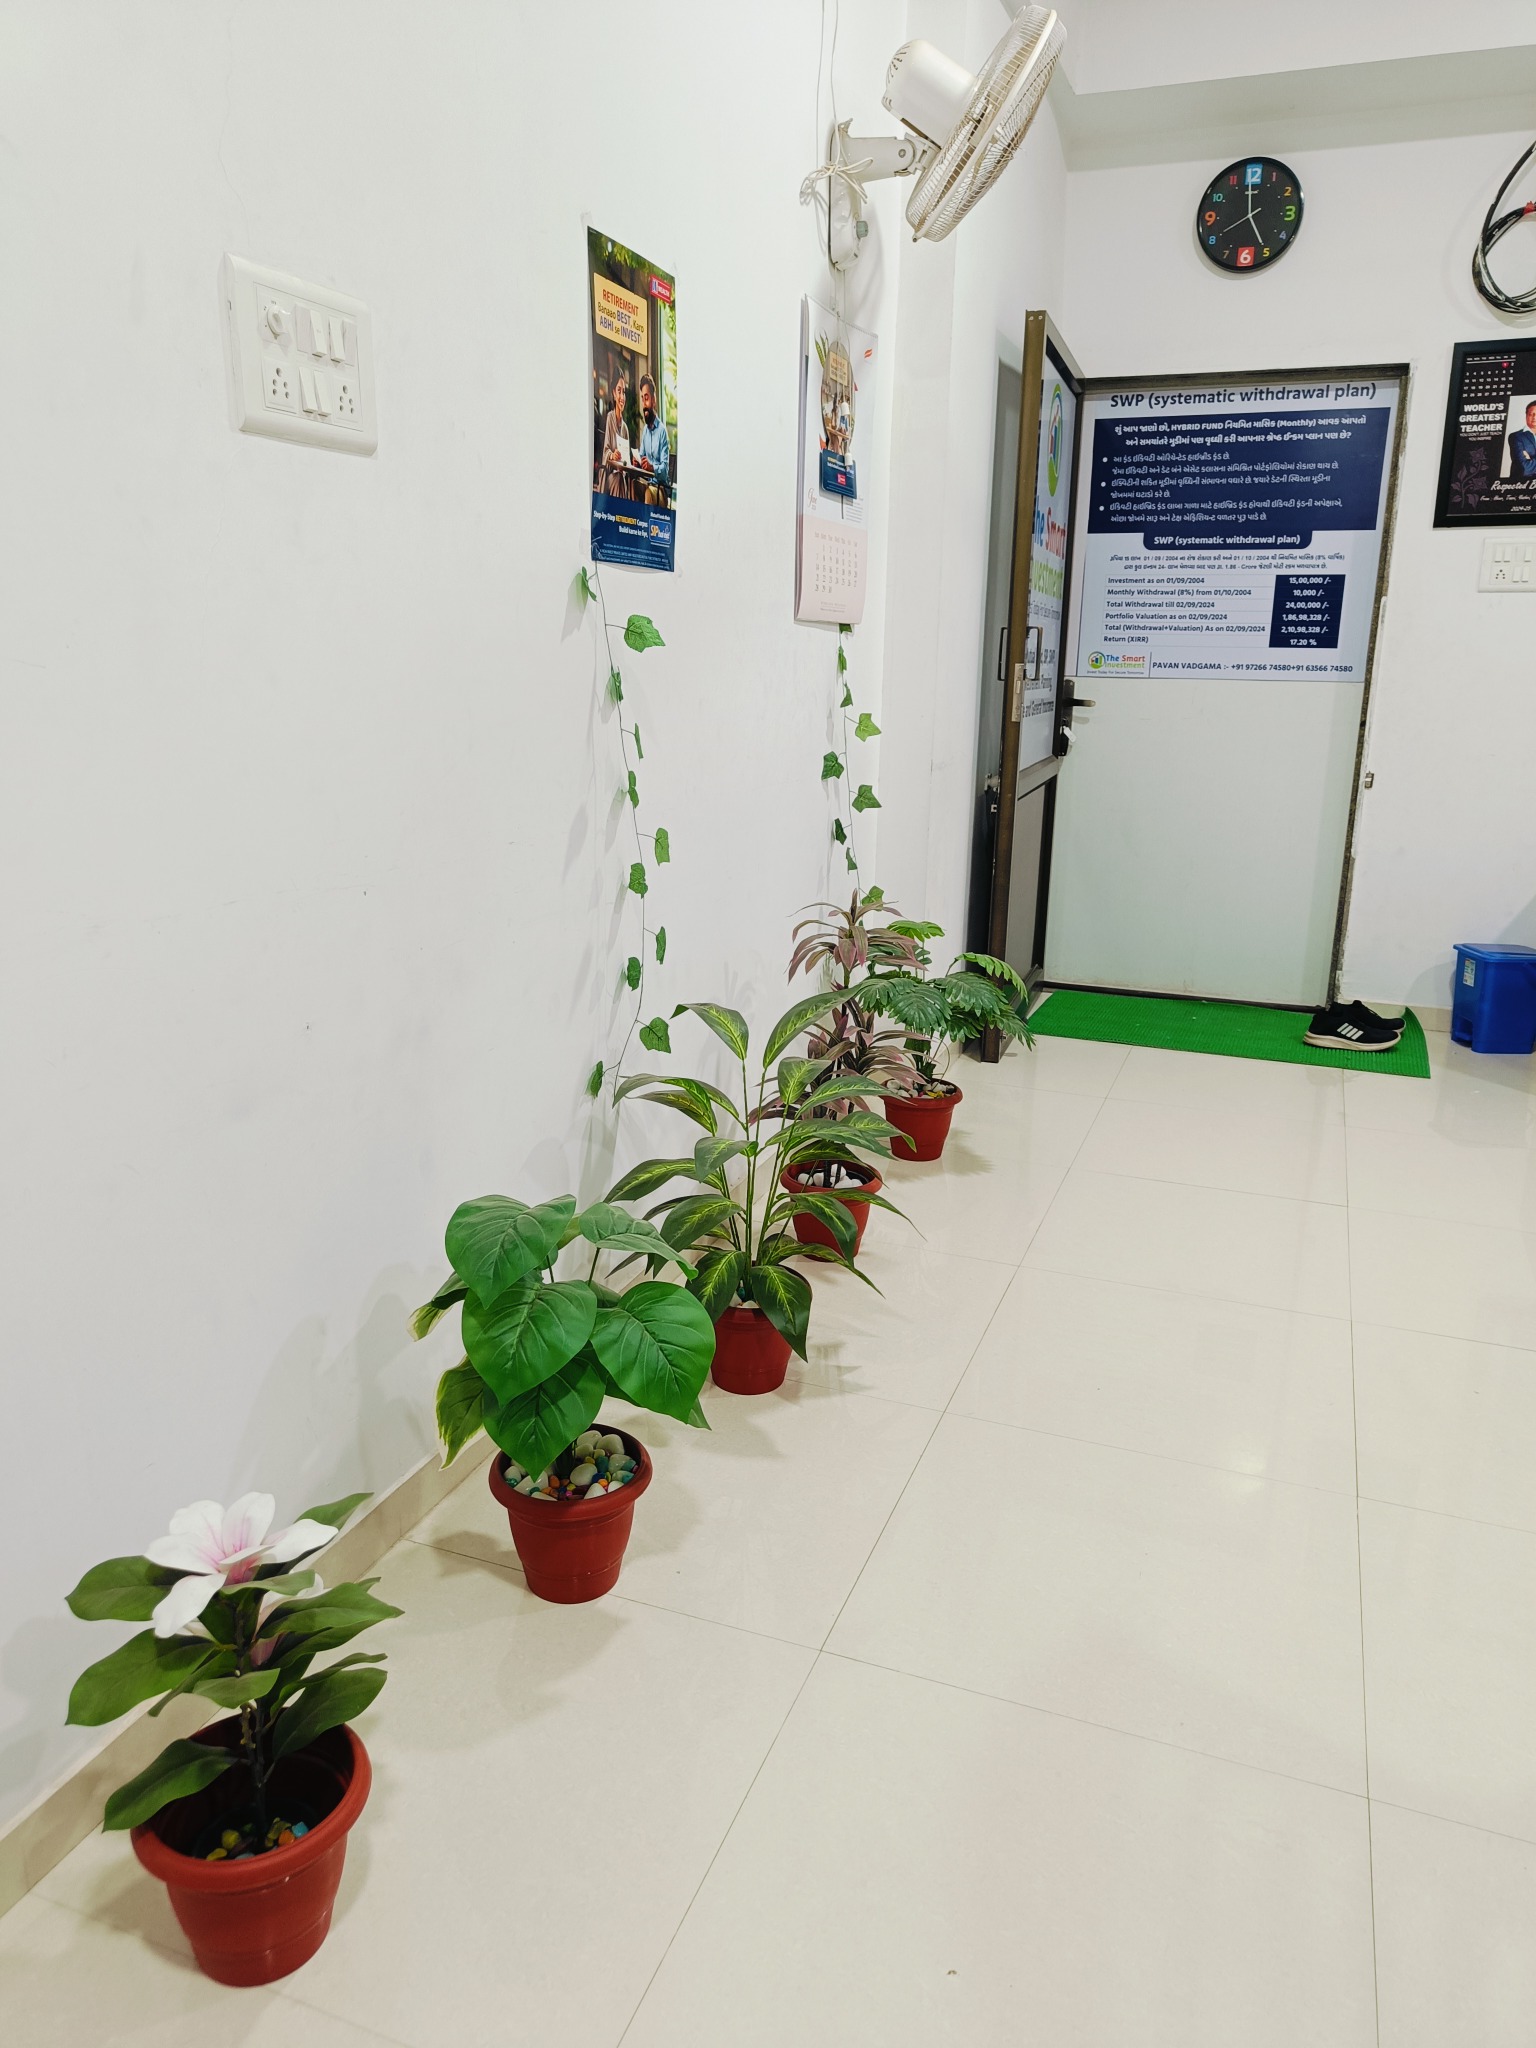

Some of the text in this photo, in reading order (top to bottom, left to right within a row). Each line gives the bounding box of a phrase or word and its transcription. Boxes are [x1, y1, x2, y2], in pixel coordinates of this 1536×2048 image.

[1247, 168, 1261, 182] 12
[1272, 173, 1277, 181] 1
[1230, 176, 1237, 184] 11
[1284, 187, 1291, 196] 2
[1213, 194, 1223, 202] 10
[1284, 206, 1295, 221] 3
[1205, 212, 1216, 225] 9
[1208, 236, 1216, 244] 8
[1279, 231, 1286, 240] 4
[1240, 250, 1251, 263] 6
[1263, 248, 1270, 256] 5
[602, 289, 638, 316] RETIREMENT
[598, 302, 616, 319] Banaao
[633, 320, 644, 333] Karo
[600, 316, 614, 332] ABHI
[1111, 383, 1376, 408] SWP (systematic withdrawal plan)
[1464, 403, 1504, 412] WORLD'S
[1459, 413, 1506, 422] GREATEST
[1277, 419, 1316, 427] (Monthly)
[1461, 424, 1502, 432] TEACHER
[1491, 480, 1529, 493] Respected
[1176, 536, 1223, 545] (systematic
[1277, 535, 1300, 544] plan)
